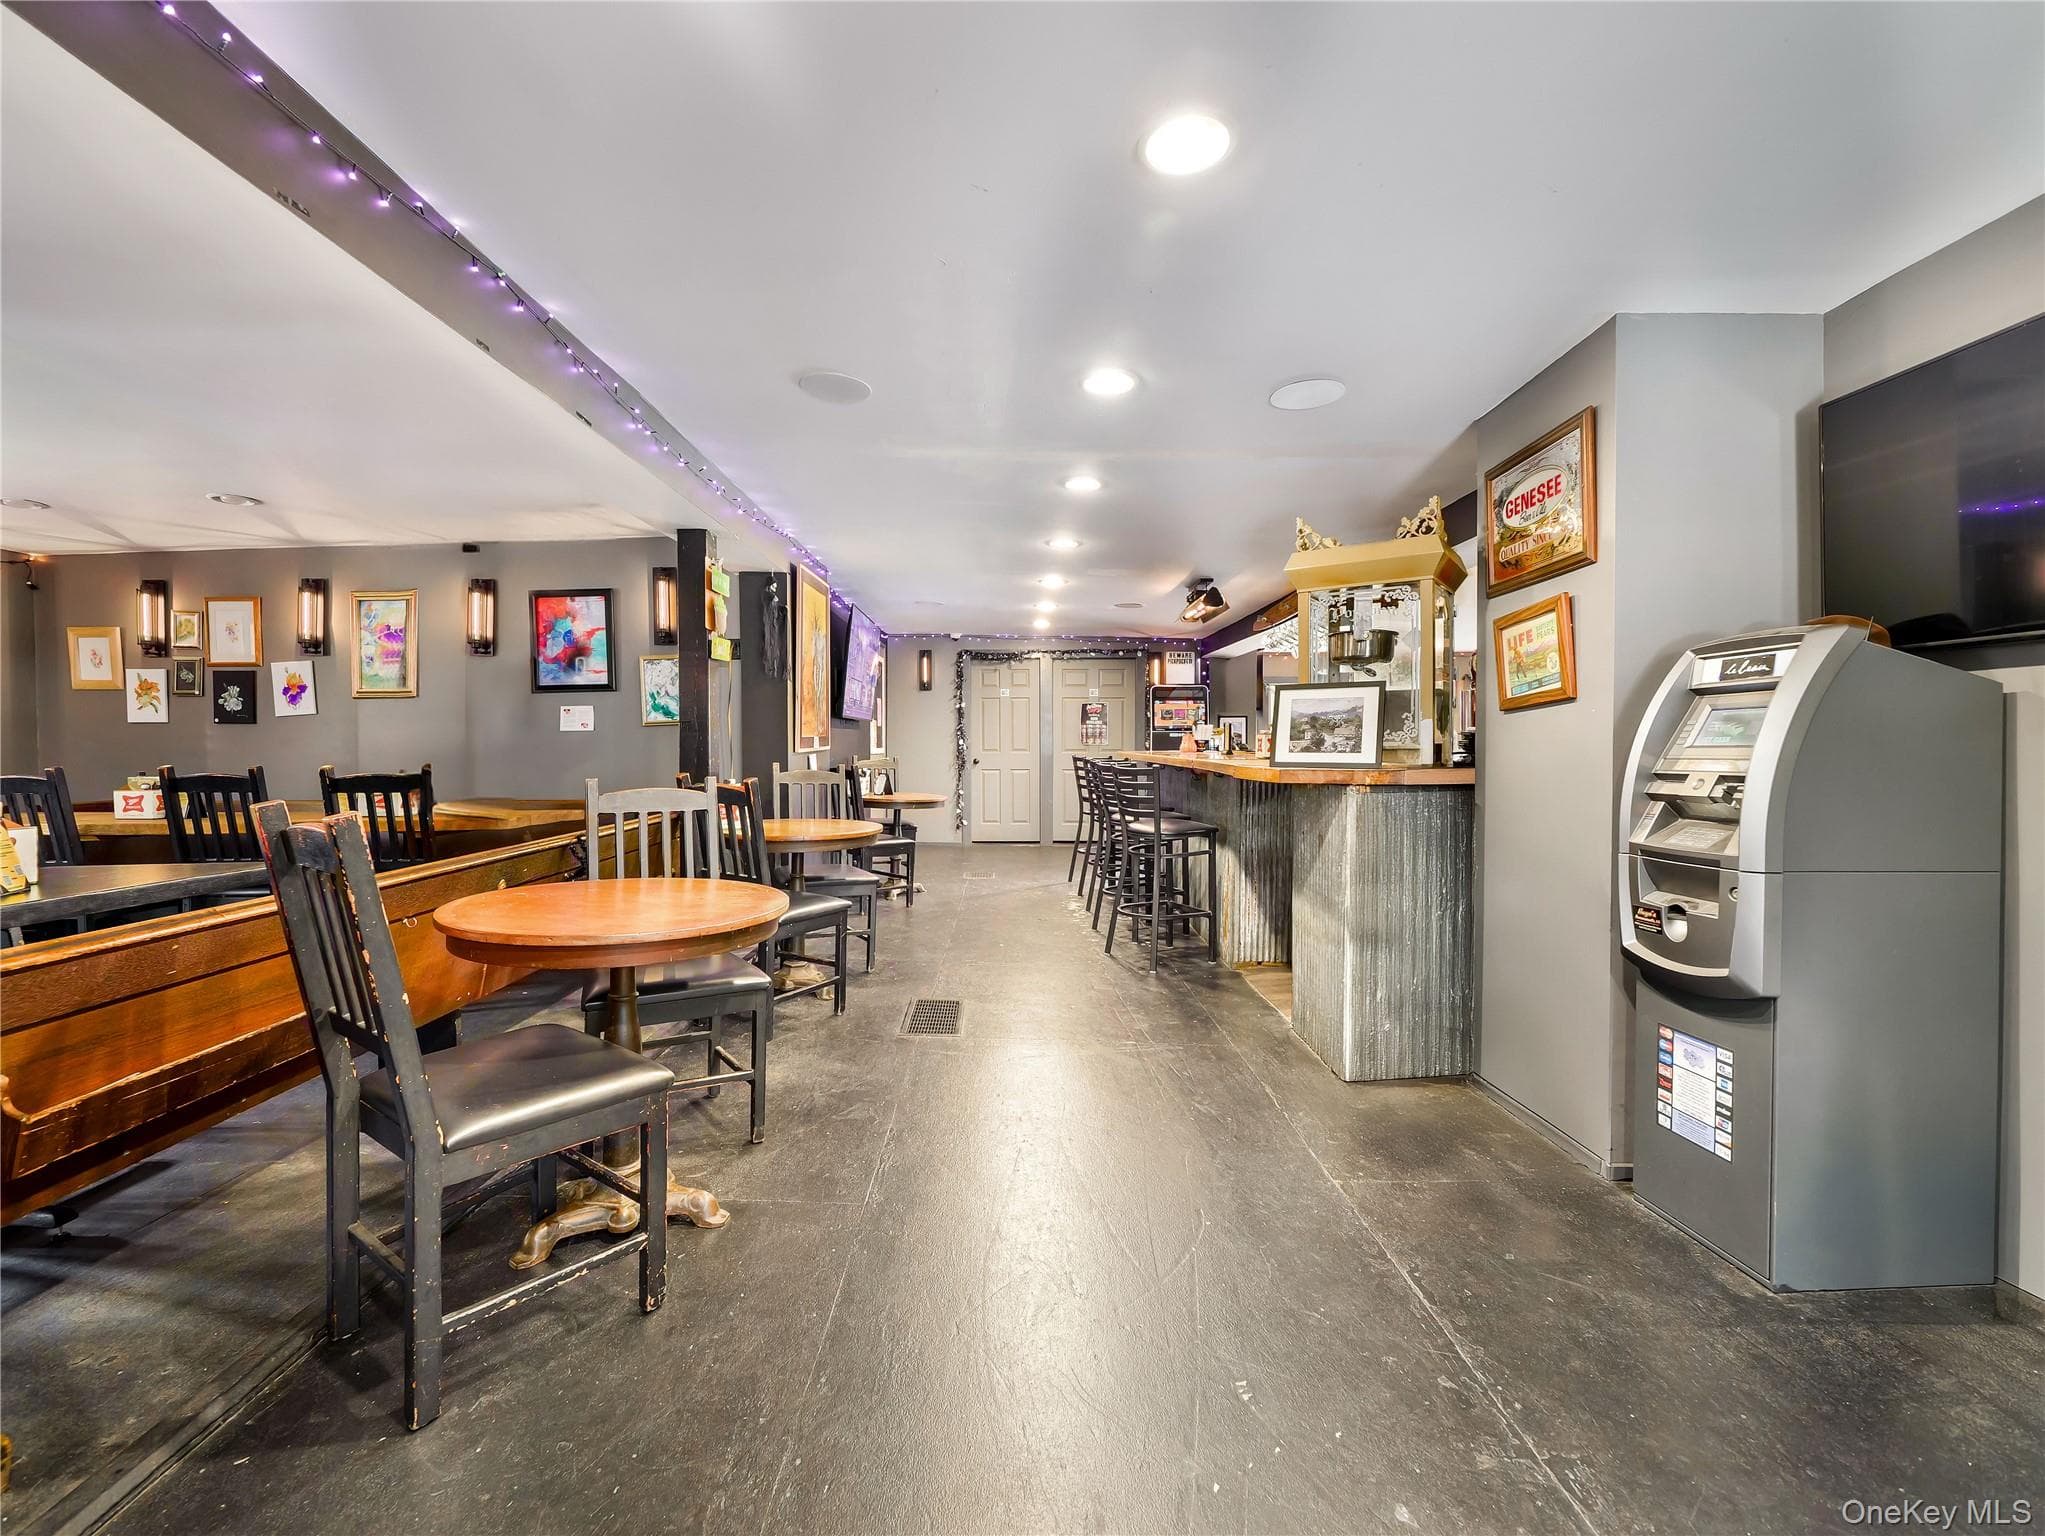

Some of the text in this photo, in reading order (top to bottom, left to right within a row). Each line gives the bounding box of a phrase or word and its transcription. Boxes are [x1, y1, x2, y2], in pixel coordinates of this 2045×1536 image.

[1505, 474, 1562, 520] GENESEE
[1501, 540, 1529, 561] QUALITY
[1507, 628, 1534, 650] LIFE
